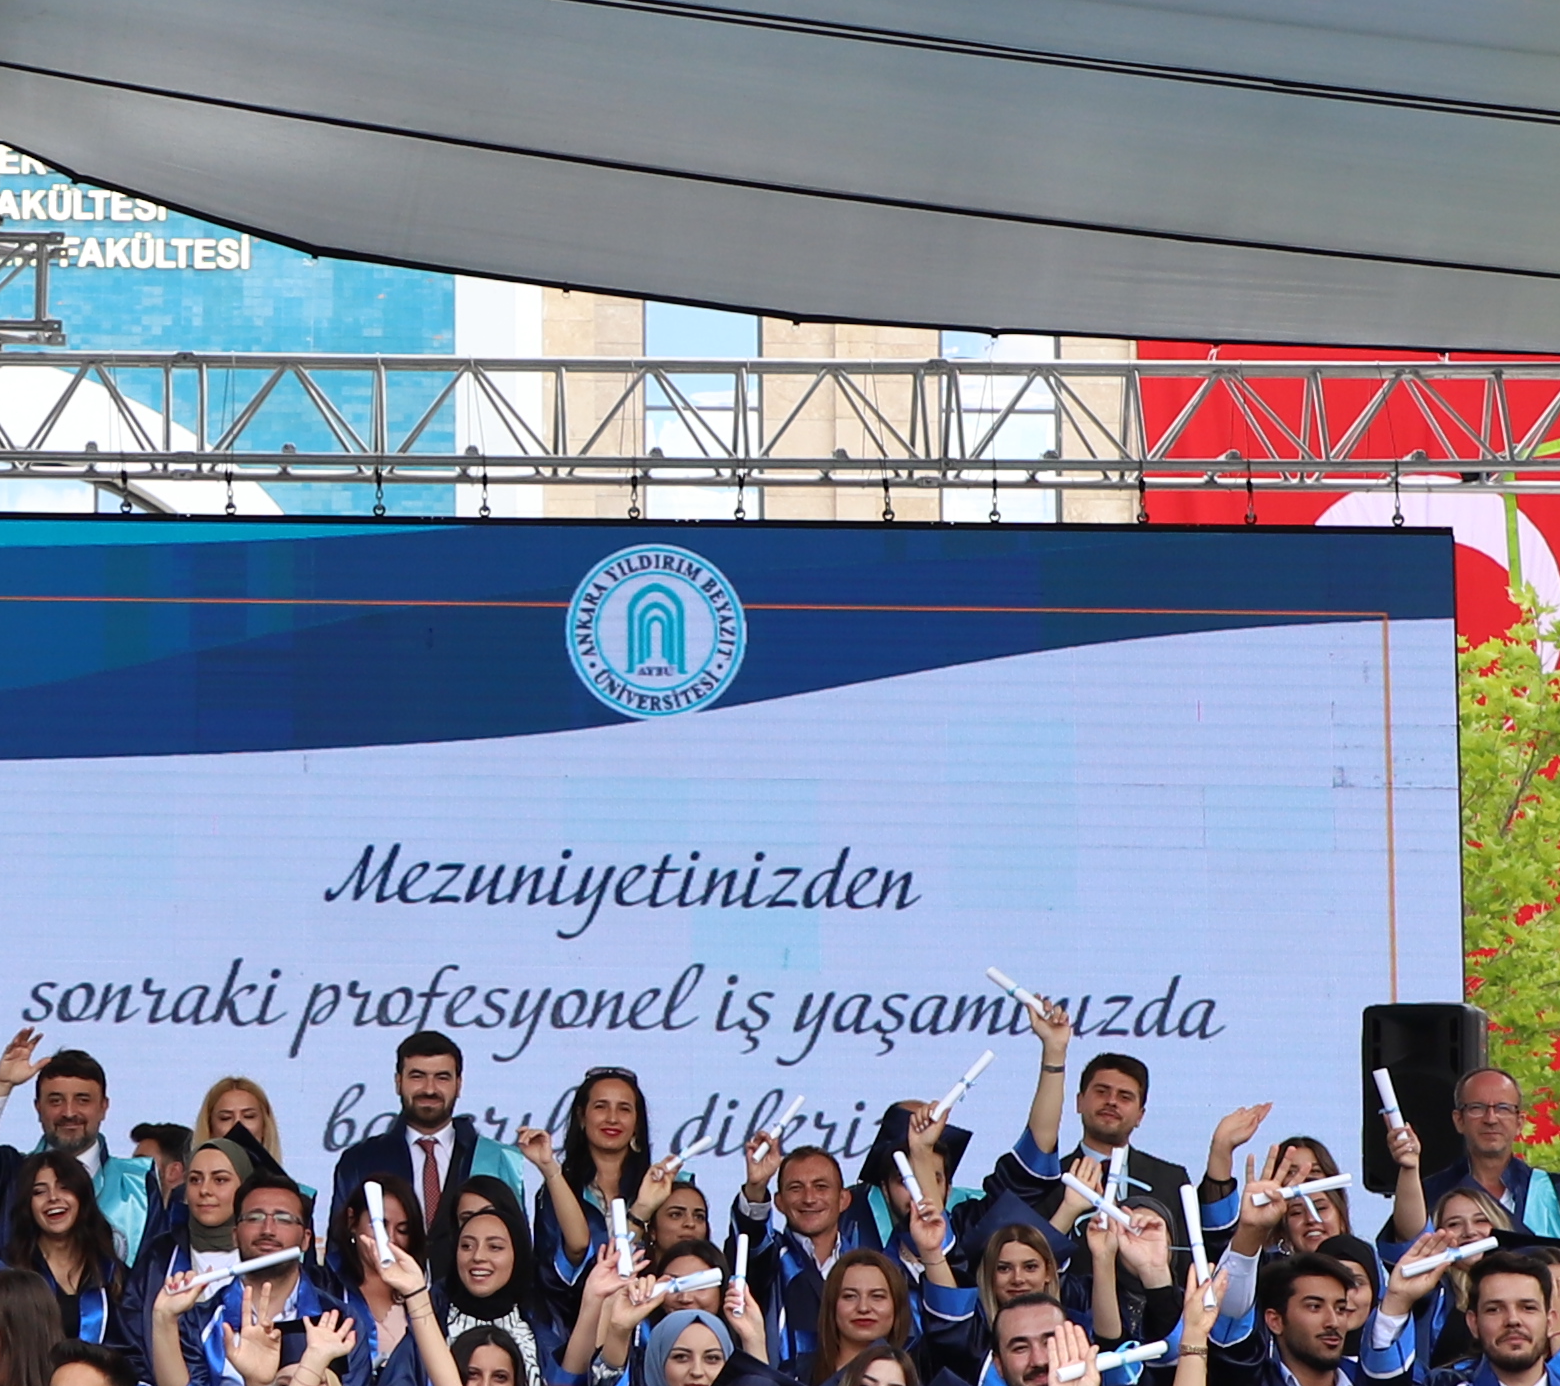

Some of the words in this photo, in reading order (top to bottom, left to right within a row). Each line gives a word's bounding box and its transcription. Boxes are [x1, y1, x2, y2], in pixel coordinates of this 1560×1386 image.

[575, 581, 609, 657] ANKARA
[603, 554, 702, 583] YILDIRIM
[700, 577, 737, 662] BEYAZIT
[593, 668, 720, 712] ÜNİVERSİTESİ
[324, 843, 921, 940] Mezuniyetinizden
[21, 957, 288, 1027] sonraki
[288, 963, 705, 1063] profesyonel
[714, 974, 775, 1054] iş
